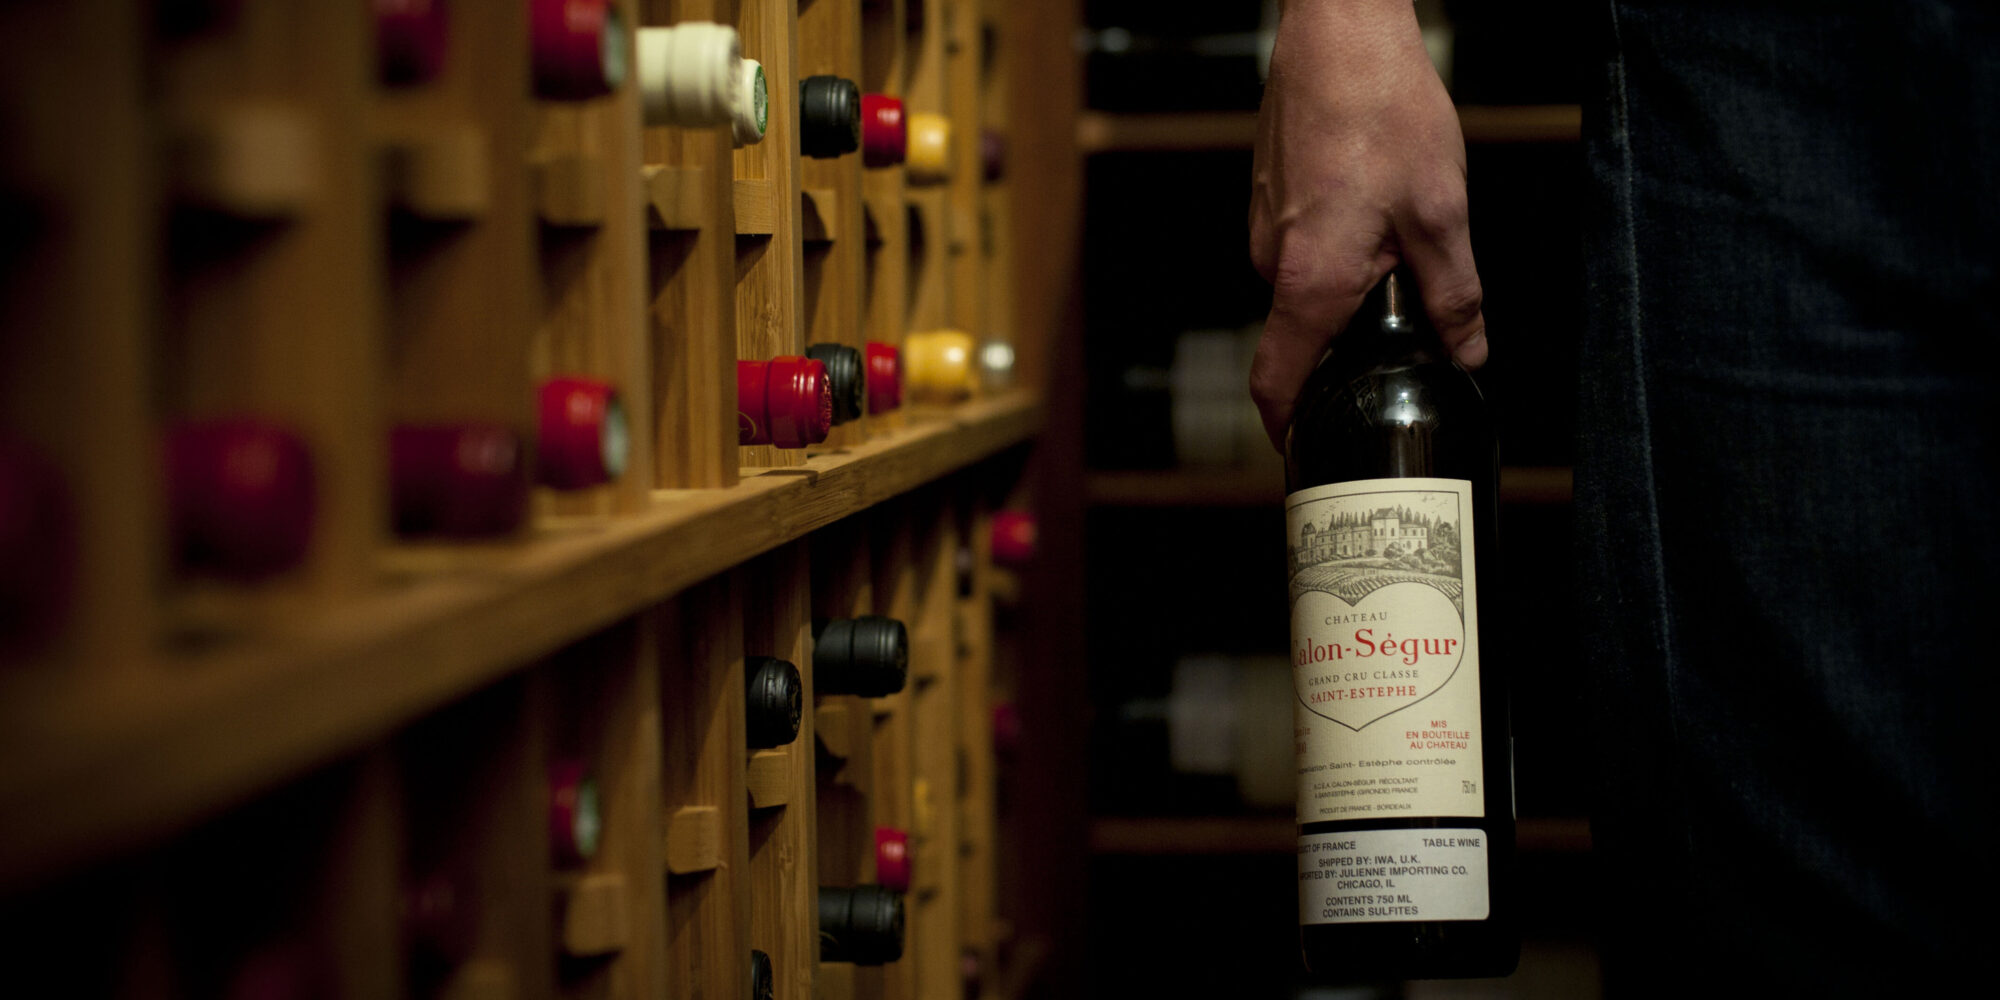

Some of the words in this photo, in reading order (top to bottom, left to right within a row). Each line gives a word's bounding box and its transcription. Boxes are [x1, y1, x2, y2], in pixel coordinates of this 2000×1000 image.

[1325, 612, 1388, 625] CHATEAU
[1308, 674, 1340, 688] GRAND
[1344, 671, 1368, 682] CRU
[1374, 669, 1419, 680] CLASSE
[1310, 685, 1417, 704] SAINT-ESTEPHE
[1431, 720, 1448, 728] MIS
[1406, 731, 1419, 740] EN
[1422, 730, 1470, 740] BOUTEILLE
[1410, 741, 1424, 750] AU
[1426, 740, 1468, 750] CHATEAU
[1312, 843, 1321, 852] OF
[1322, 841, 1356, 851] FRANCE
[1422, 838, 1455, 848] TABLE
[1458, 838, 1480, 848] WINE
[1318, 856, 1353, 868] SHIPPED
[1356, 856, 1372, 866] BY:
[1374, 855, 1397, 865] IWA,
[1400, 854, 1421, 864] U.K.
[1324, 869, 1338, 880] BY:
[1339, 867, 1386, 878] JULIENNE
[1389, 866, 1448, 876] IMPORTING
[1452, 866, 1468, 876] CO.
[1337, 880, 1384, 890] CHICAGO,
[1386, 880, 1396, 888] IL
[1326, 896, 1374, 906] CONTENTS
[1376, 895, 1394, 904] 750
[1397, 894, 1412, 904] ML
[1322, 907, 1366, 918] CONTAINS
[1368, 906, 1419, 916] SULFITES
